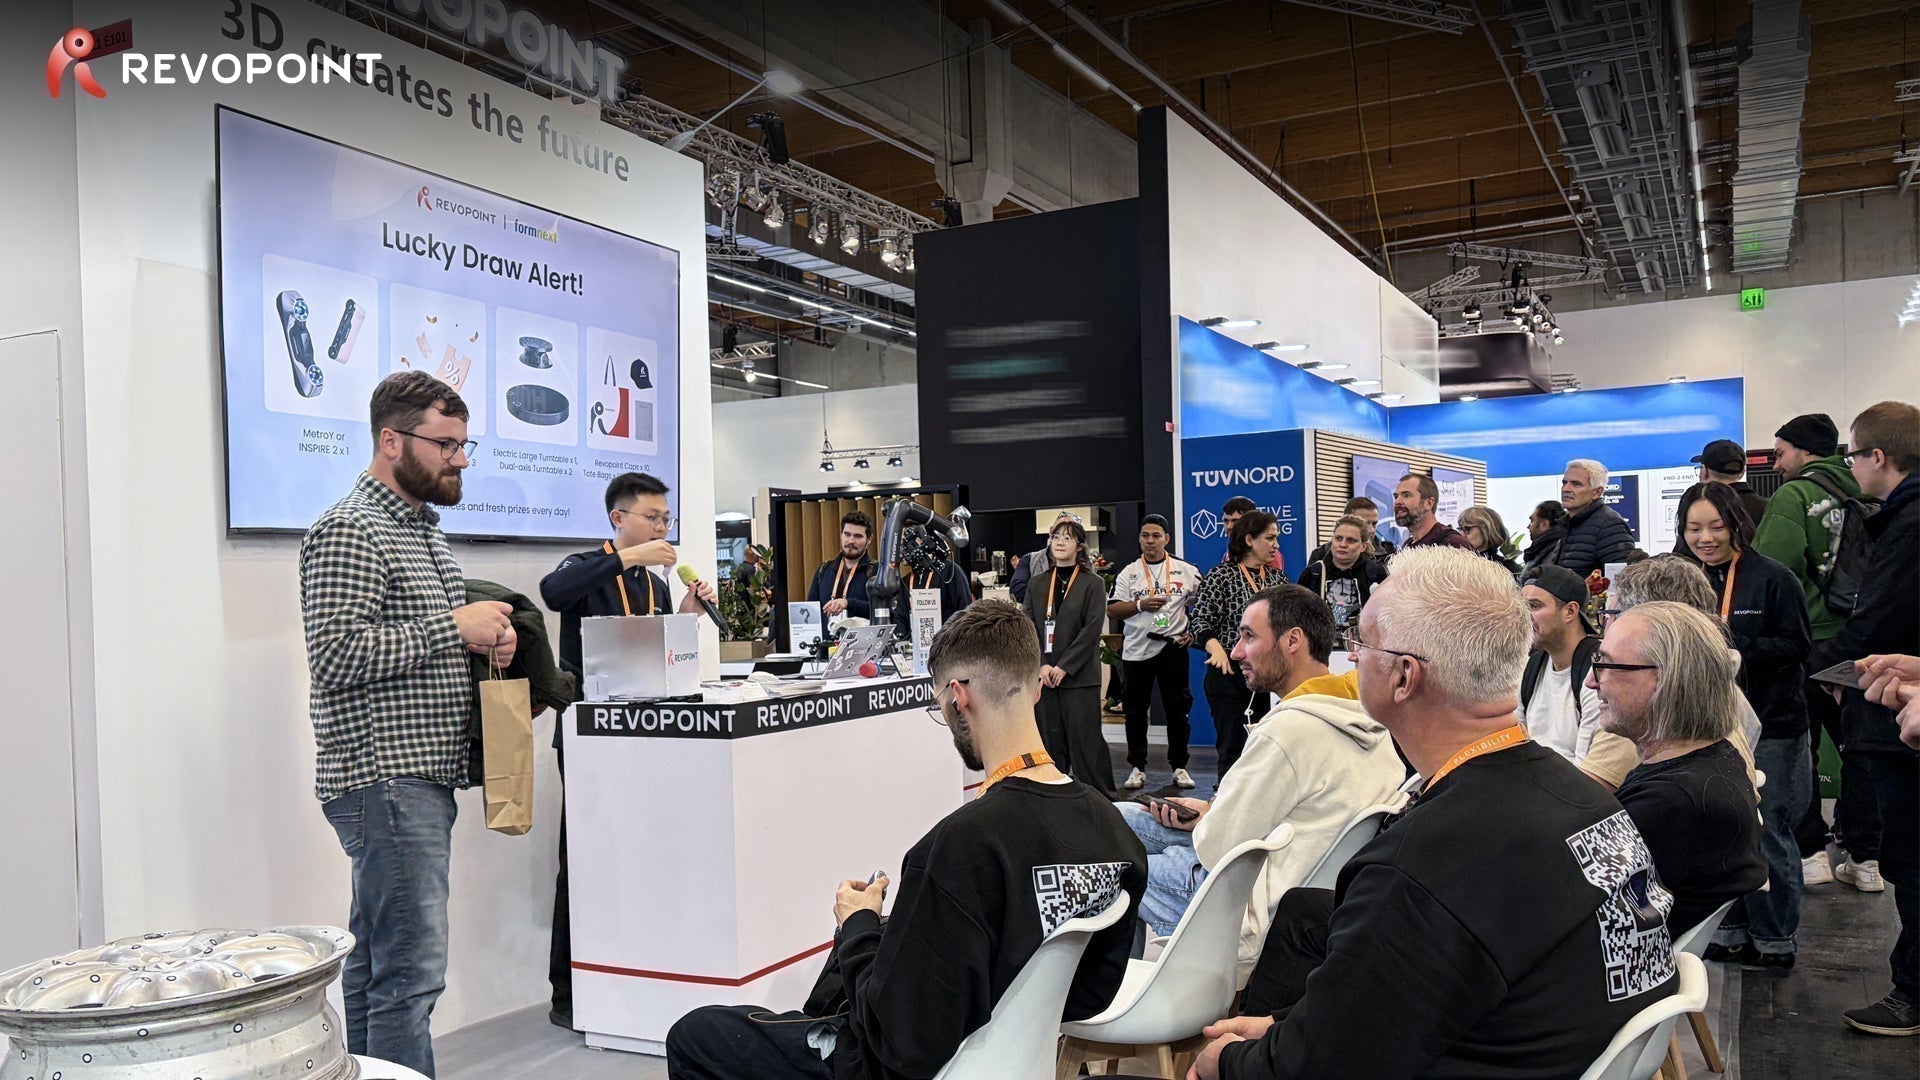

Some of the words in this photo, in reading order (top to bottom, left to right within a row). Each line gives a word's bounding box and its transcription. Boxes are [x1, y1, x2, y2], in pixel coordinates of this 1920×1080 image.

[220, 0, 284, 51] 3D
[467, 92, 523, 144] the
[538, 115, 630, 182] future
[436, 197, 497, 225] REVOPOINT
[514, 218, 559, 244] formnext
[382, 222, 457, 271] Lucky
[463, 243, 523, 281] Draw
[528, 262, 584, 296] Alert!
[303, 429, 335, 440] MetroY
[336, 433, 345, 441] or
[298, 442, 331, 454] INSPIRE
[332, 445, 338, 455] 2
[493, 448, 518, 459] Electric
[519, 451, 538, 462] Large
[539, 453, 569, 464] Turntable
[499, 461, 532, 472] Dual-axis
[533, 464, 563, 475] Turntable
[568, 468, 573, 476] 2
[594, 459, 624, 470] Revopoint
[624, 462, 640, 471] Caps
[467, 502, 484, 512] and
[485, 502, 506, 513] fresh
[507, 504, 531, 516] prizes
[532, 507, 553, 518] every
[554, 506, 571, 518] day!
[674, 651, 698, 662] REVOPOINT
[594, 708, 737, 733] REVOPOINT
[757, 694, 853, 729] REVOPOINT
[868, 682, 936, 711] REVOPOIN
[1453, 732, 1512, 765] FLEXIBILITY
